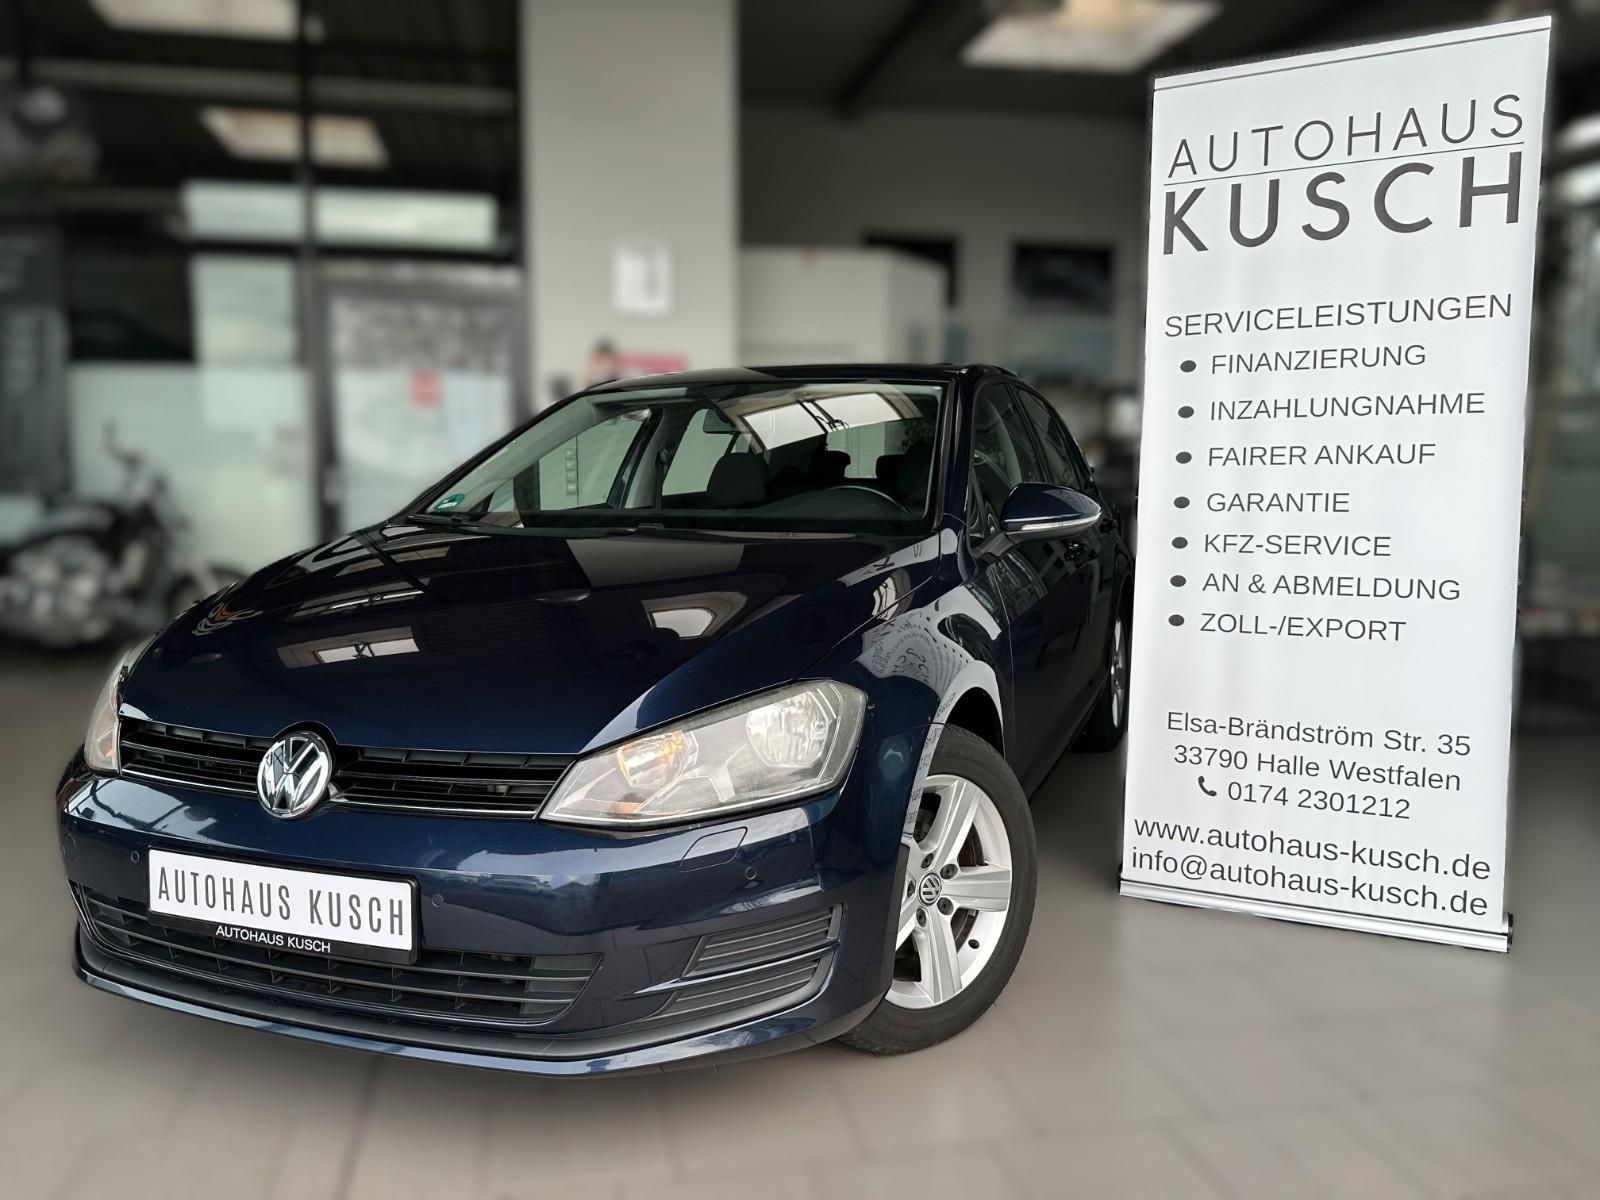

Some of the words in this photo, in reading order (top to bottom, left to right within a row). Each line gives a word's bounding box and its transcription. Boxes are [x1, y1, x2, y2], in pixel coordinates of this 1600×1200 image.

[1167, 93, 1524, 179] AUTOHAUS
[1162, 150, 1523, 256] KUSCH
[1164, 293, 1512, 338] SERVICELEISTUNGEN
[1210, 344, 1427, 375] FINANZIERUNG
[1209, 392, 1486, 421] INZAHLUNGNAHME
[1207, 446, 1308, 467] FAIRER
[1313, 443, 1437, 466] ANKAUF
[1206, 492, 1350, 513] GARANTIE
[1203, 533, 1392, 557] KFZ-SERVICE
[1201, 572, 1240, 593] AN
[1247, 573, 1267, 594] &
[1272, 574, 1461, 601] ABMELDUNG
[1199, 612, 1407, 642] ZOLL-/EXPORT
[1167, 711, 1374, 749] Elsa-Brändström
[1383, 729, 1427, 753] Str.
[1437, 733, 1472, 757] 35
[1173, 744, 1248, 770] 33790
[1257, 752, 1321, 778] Halle
[1328, 759, 1461, 792] Westfalen
[1227, 781, 1289, 807] 0174
[1297, 788, 1411, 820] 2301212
[1133, 819, 1491, 880] www.autohaus-kusch.de
[1131, 846, 1488, 916] info@autohaus-kusch.de
[158, 866, 291, 921] AUTOHAUS
[308, 888, 404, 937] KUSCH
[215, 925, 284, 946] AUTOHAUS
[287, 936, 331, 953] KUSCH
